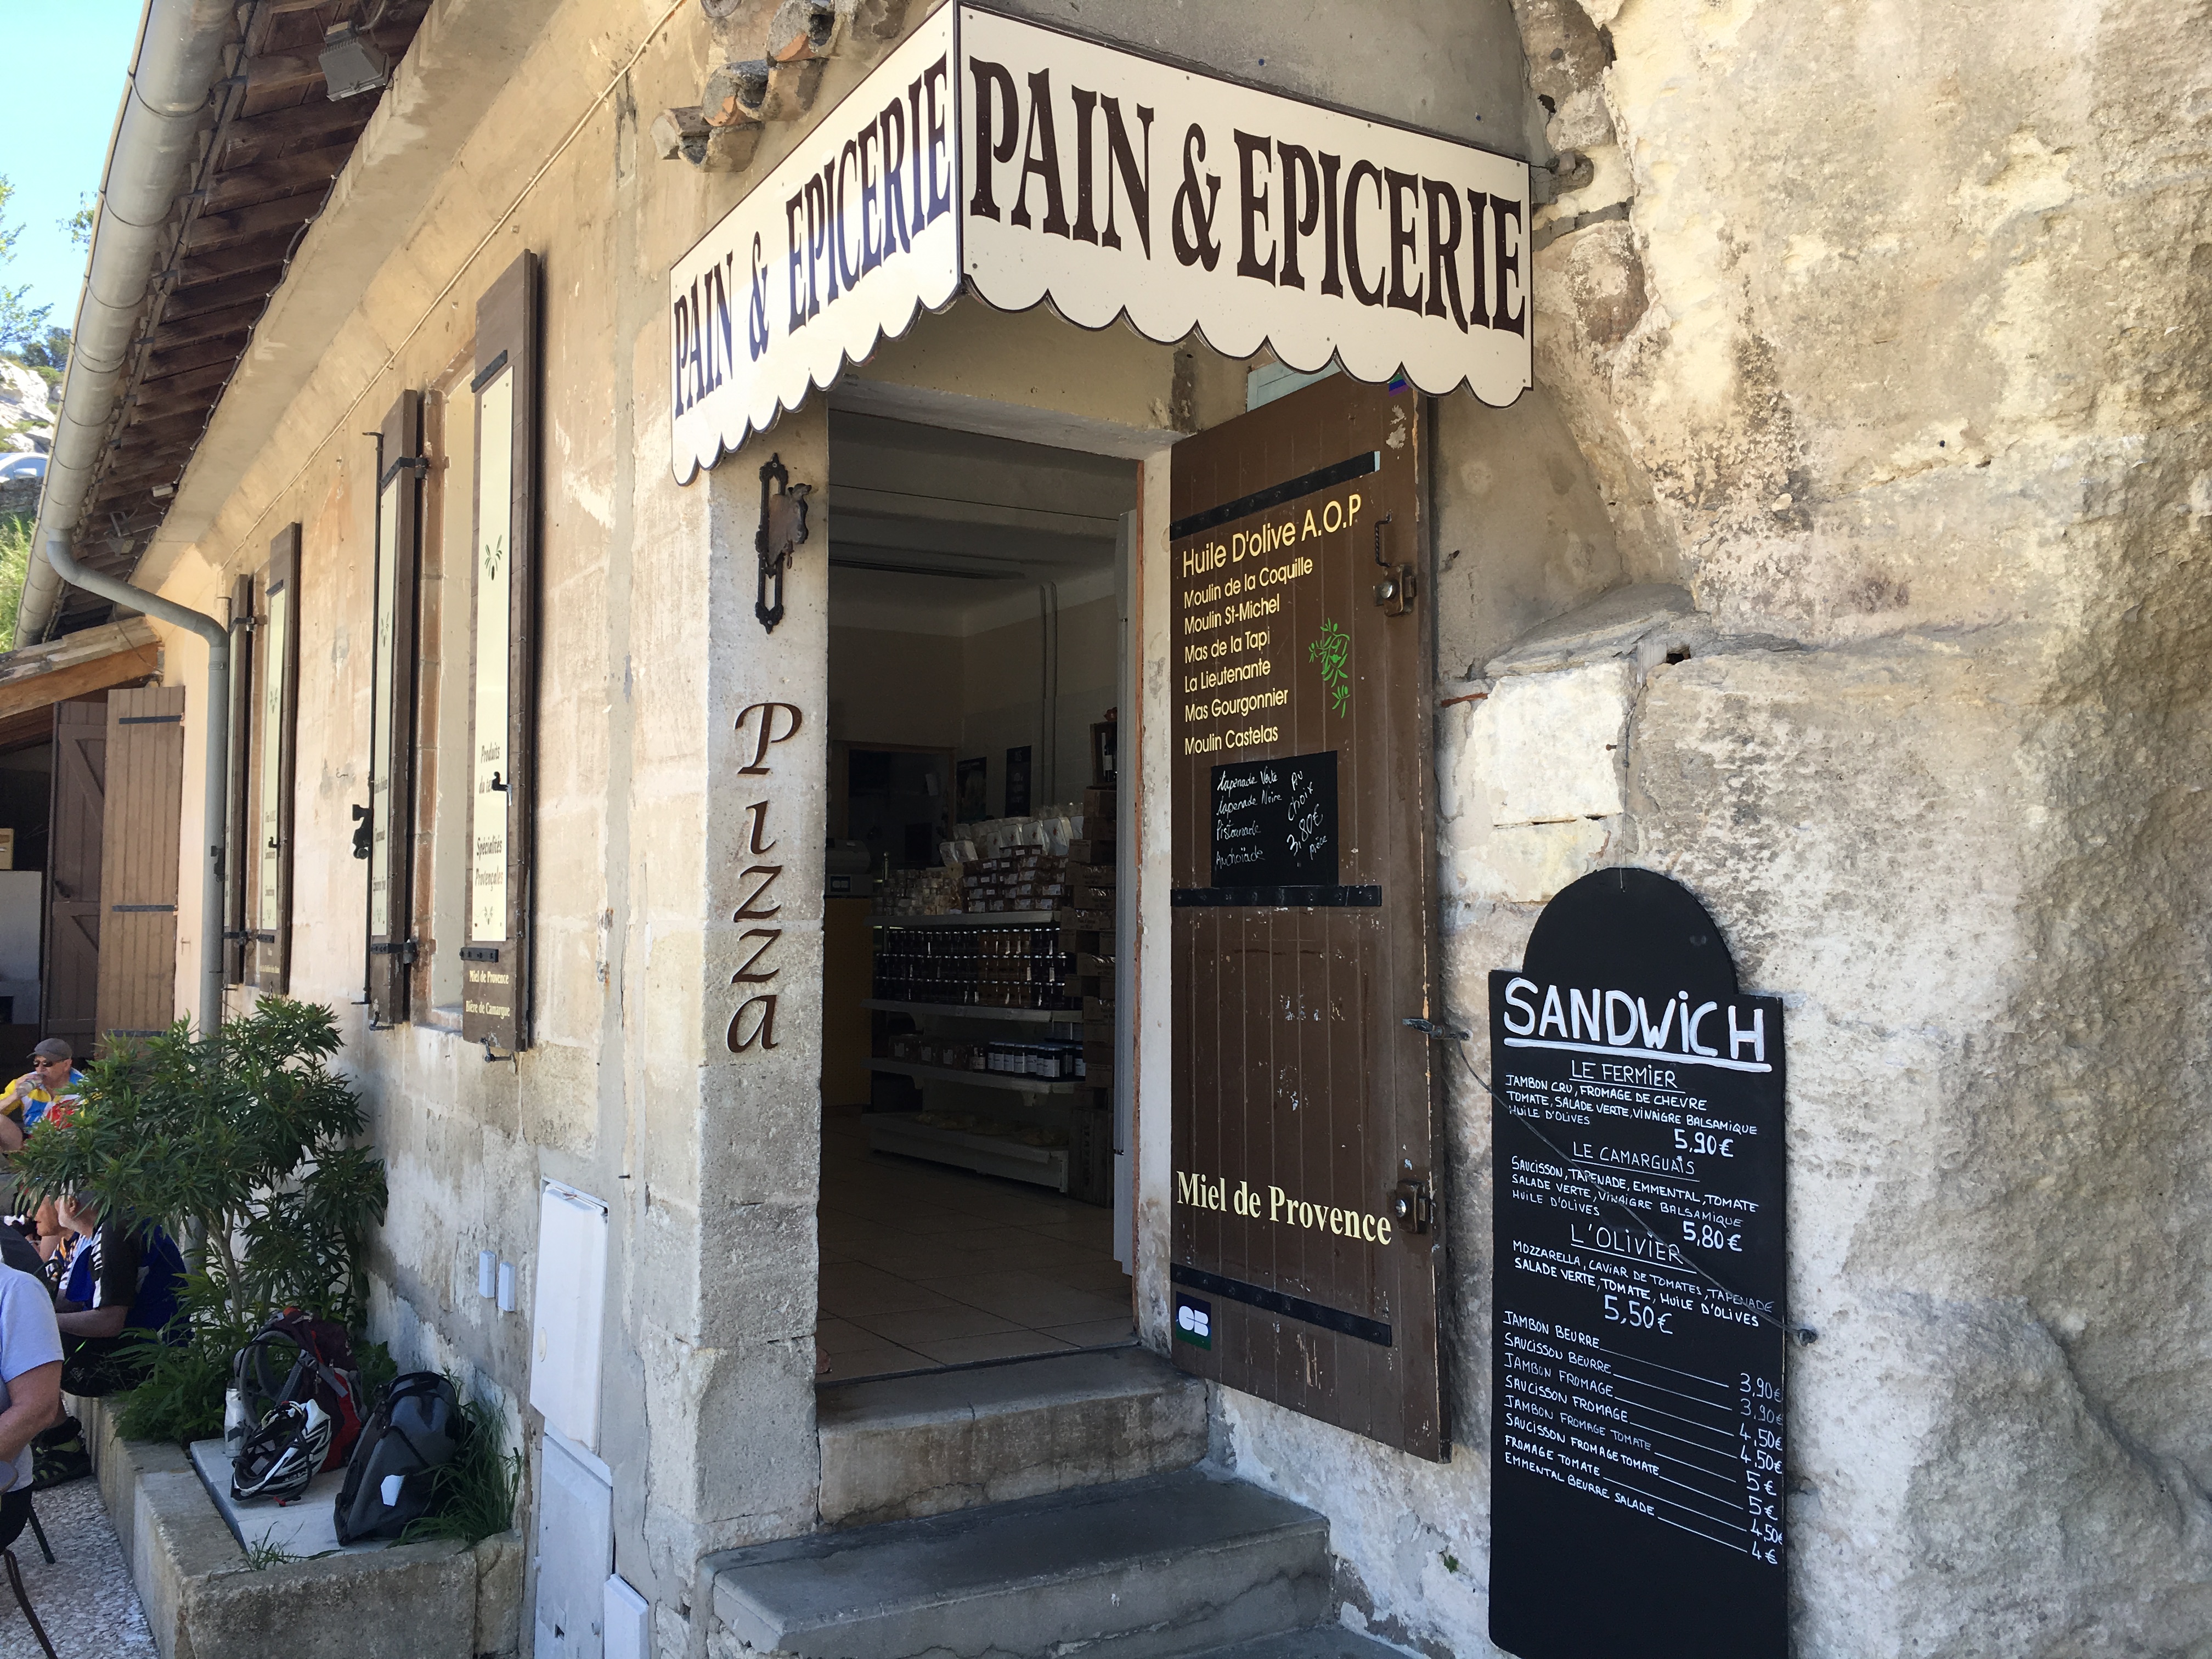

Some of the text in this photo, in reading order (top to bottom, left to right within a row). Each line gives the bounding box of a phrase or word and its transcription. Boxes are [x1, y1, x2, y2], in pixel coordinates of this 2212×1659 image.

[968, 55, 1526, 340] PAIN & EPICERIE
[674, 48, 951, 421] PAIN & EPICERIE
[1183, 494, 1362, 578] Huile D'olive A.O.P
[1184, 556, 1313, 609] Moulin de la Coquille
[1184, 594, 1280, 635] Moulin St-Michel
[1184, 644, 1208, 664] Mas
[1211, 636, 1227, 658] de
[1230, 634, 1243, 653] la
[1184, 658, 1271, 693] La Lieutenante
[1184, 688, 1288, 723] Mas Gourgonnier
[481, 742, 500, 764] Produits
[1184, 724, 1278, 755] Moulin Castelas
[477, 834, 502, 861] Spécialités
[475, 865, 503, 891] Provençales
[726, 702, 802, 1053] Pizza
[470, 970, 509, 984] Miel de Provence
[466, 1000, 510, 1019] Bière de Camargue
[1572, 1060, 1596, 1079] LE
[1505, 1075, 1547, 1090] JAMBON
[1579, 1085, 1632, 1101] FROMAGE
[1635, 1092, 1650, 1104] DE
[1654, 1095, 1707, 1111] CHEVRE
[1555, 1096, 1594, 1111] SALADE
[1573, 1141, 1593, 1159] LE
[1511, 1173, 1551, 1190] SALADE
[1176, 1171, 1391, 1245] Miel de Provence
[1704, 1194, 1759, 1212] TOMATE
[1515, 1257, 1557, 1277] SALADE
[1633, 1270, 1647, 1282] DE
[1707, 1289, 1775, 1313] TAPENADE
[1503, 1311, 1549, 1334] JAMBON
[1555, 1325, 1599, 1348] BEURRE
[1504, 1352, 1551, 1378] JAMBON
[1559, 1370, 1613, 1397] FROMAGE
[1568, 1352, 1611, 1374] BEURRE
[1504, 1395, 1553, 1419] JAMBON
[1560, 1412, 1606, 1436] FROMAGE
[1610, 1430, 1651, 1451] TOMATE
[1572, 1396, 1628, 1423] FROMAGE
[1505, 1435, 1554, 1460] FROMAGE
[1558, 1454, 1600, 1476] TOMATE
[1571, 1437, 1618, 1462] FROMAGE
[1620, 1454, 1660, 1476] TOMATE
[1505, 1452, 1565, 1482] EMMENTAL
[1568, 1474, 1610, 1499] BEURRE
[1615, 1492, 1655, 1516] SALADE
